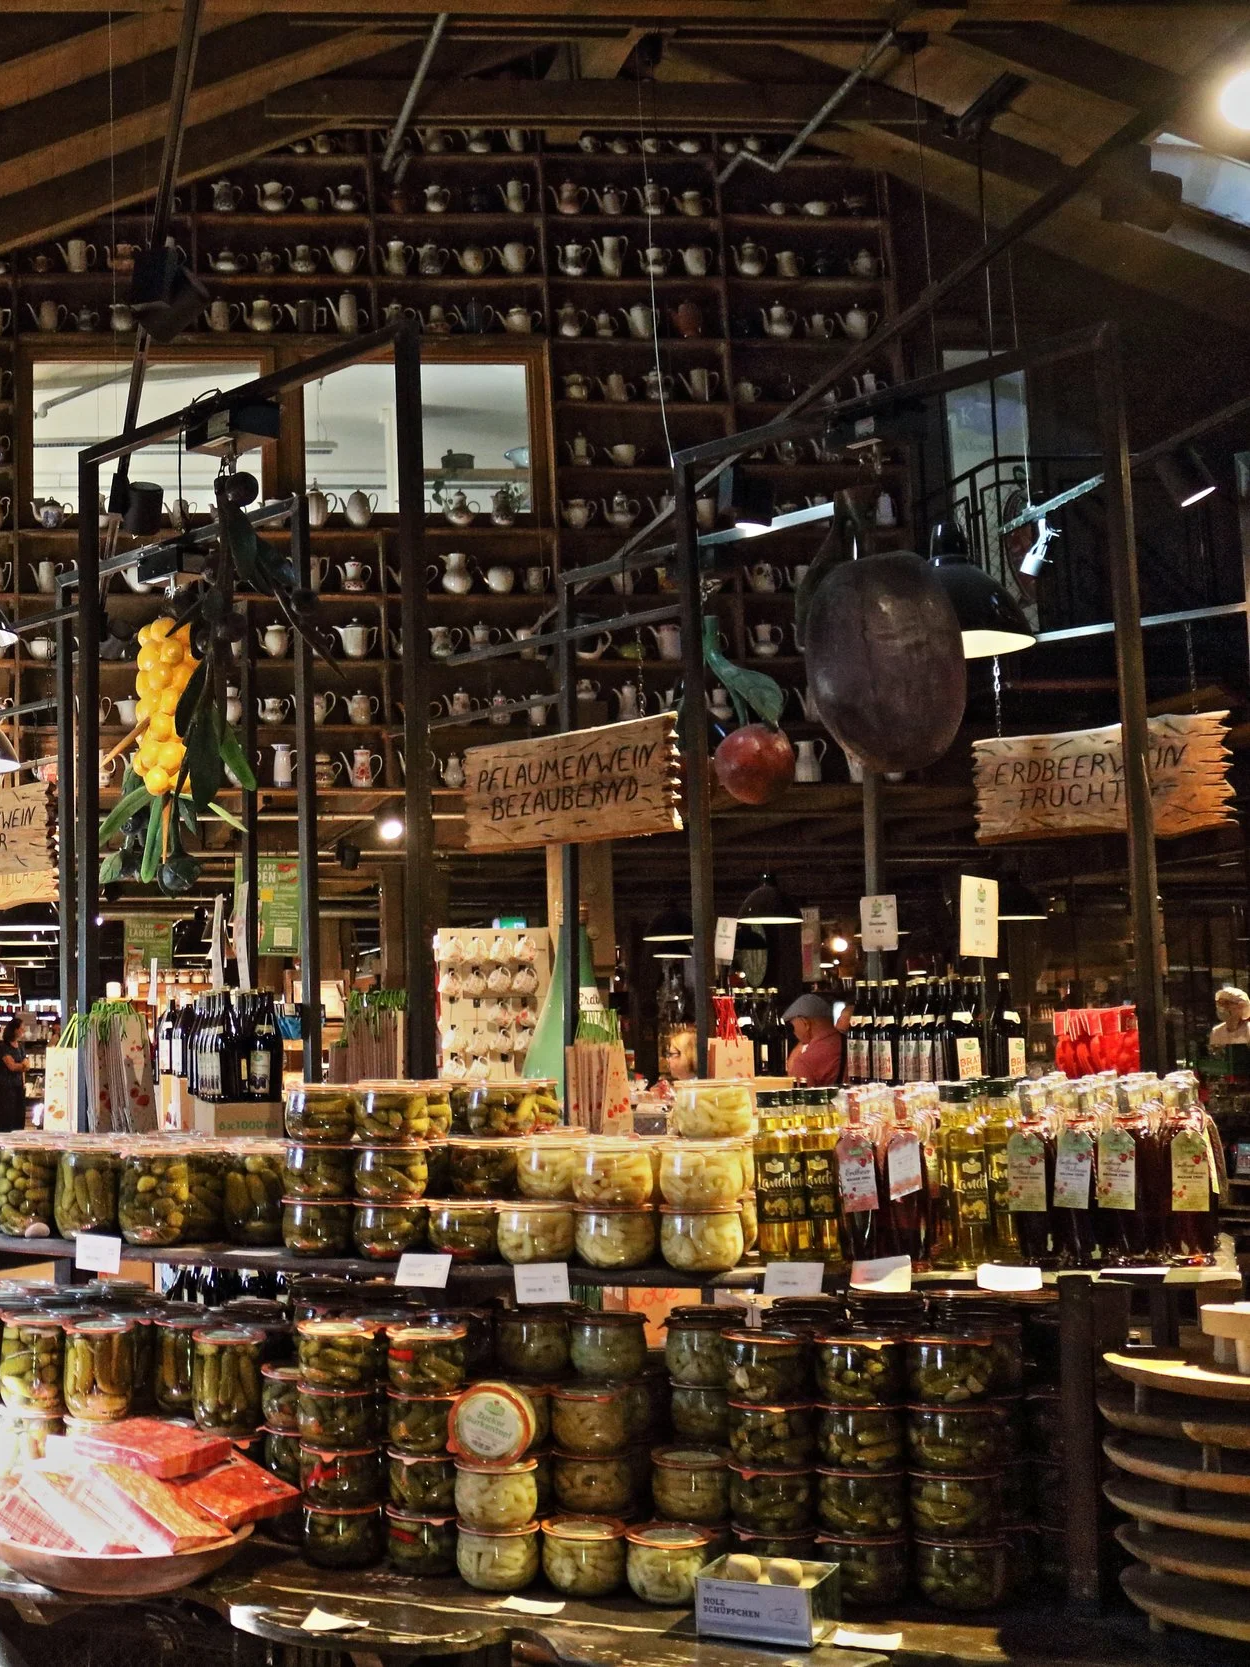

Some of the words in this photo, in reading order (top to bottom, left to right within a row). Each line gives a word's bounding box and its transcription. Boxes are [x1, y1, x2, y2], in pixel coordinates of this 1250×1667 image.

[477, 742, 658, 792] PFLAUMENWEIN
[994, 743, 1188, 786] ERDBEERWIN
[703, 1597, 726, 1607] HOLZ
